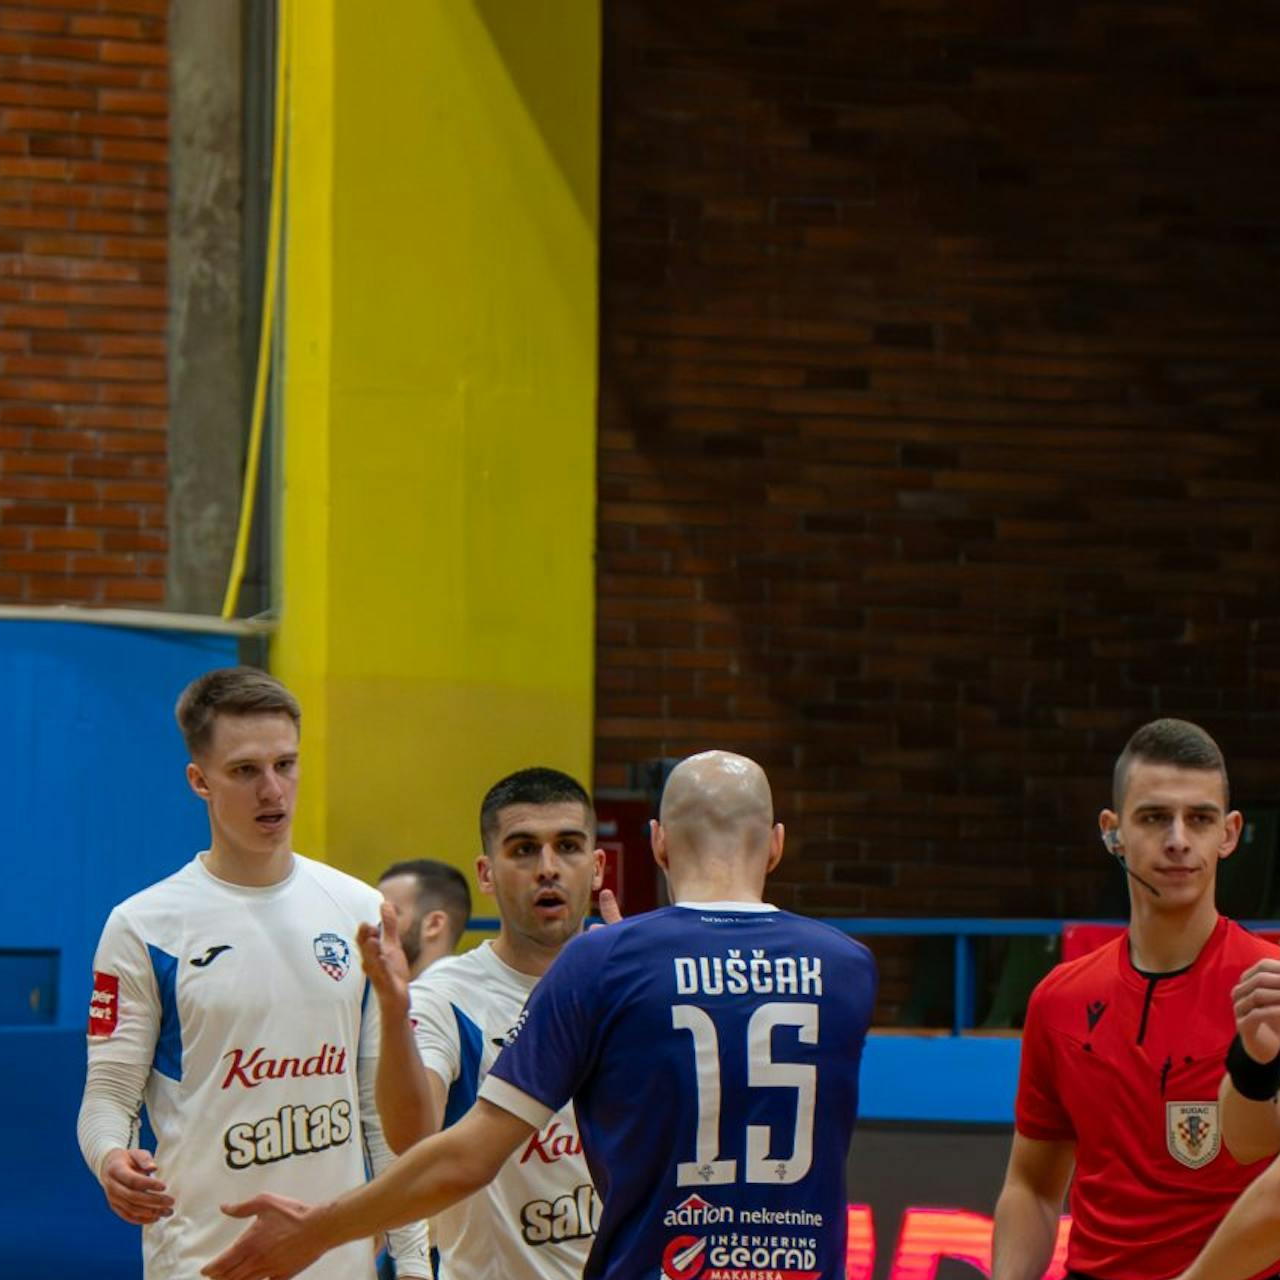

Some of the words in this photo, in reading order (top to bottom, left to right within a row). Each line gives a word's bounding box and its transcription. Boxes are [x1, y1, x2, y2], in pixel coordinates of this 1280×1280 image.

[674, 950, 823, 996] DUŠČAK
[222, 1044, 347, 1089] Kandit
[672, 1002, 819, 1187] 15
[224, 1099, 352, 1170] saltas
[663, 1204, 734, 1227] adrion
[710, 1233, 817, 1249] INŽENJERING
